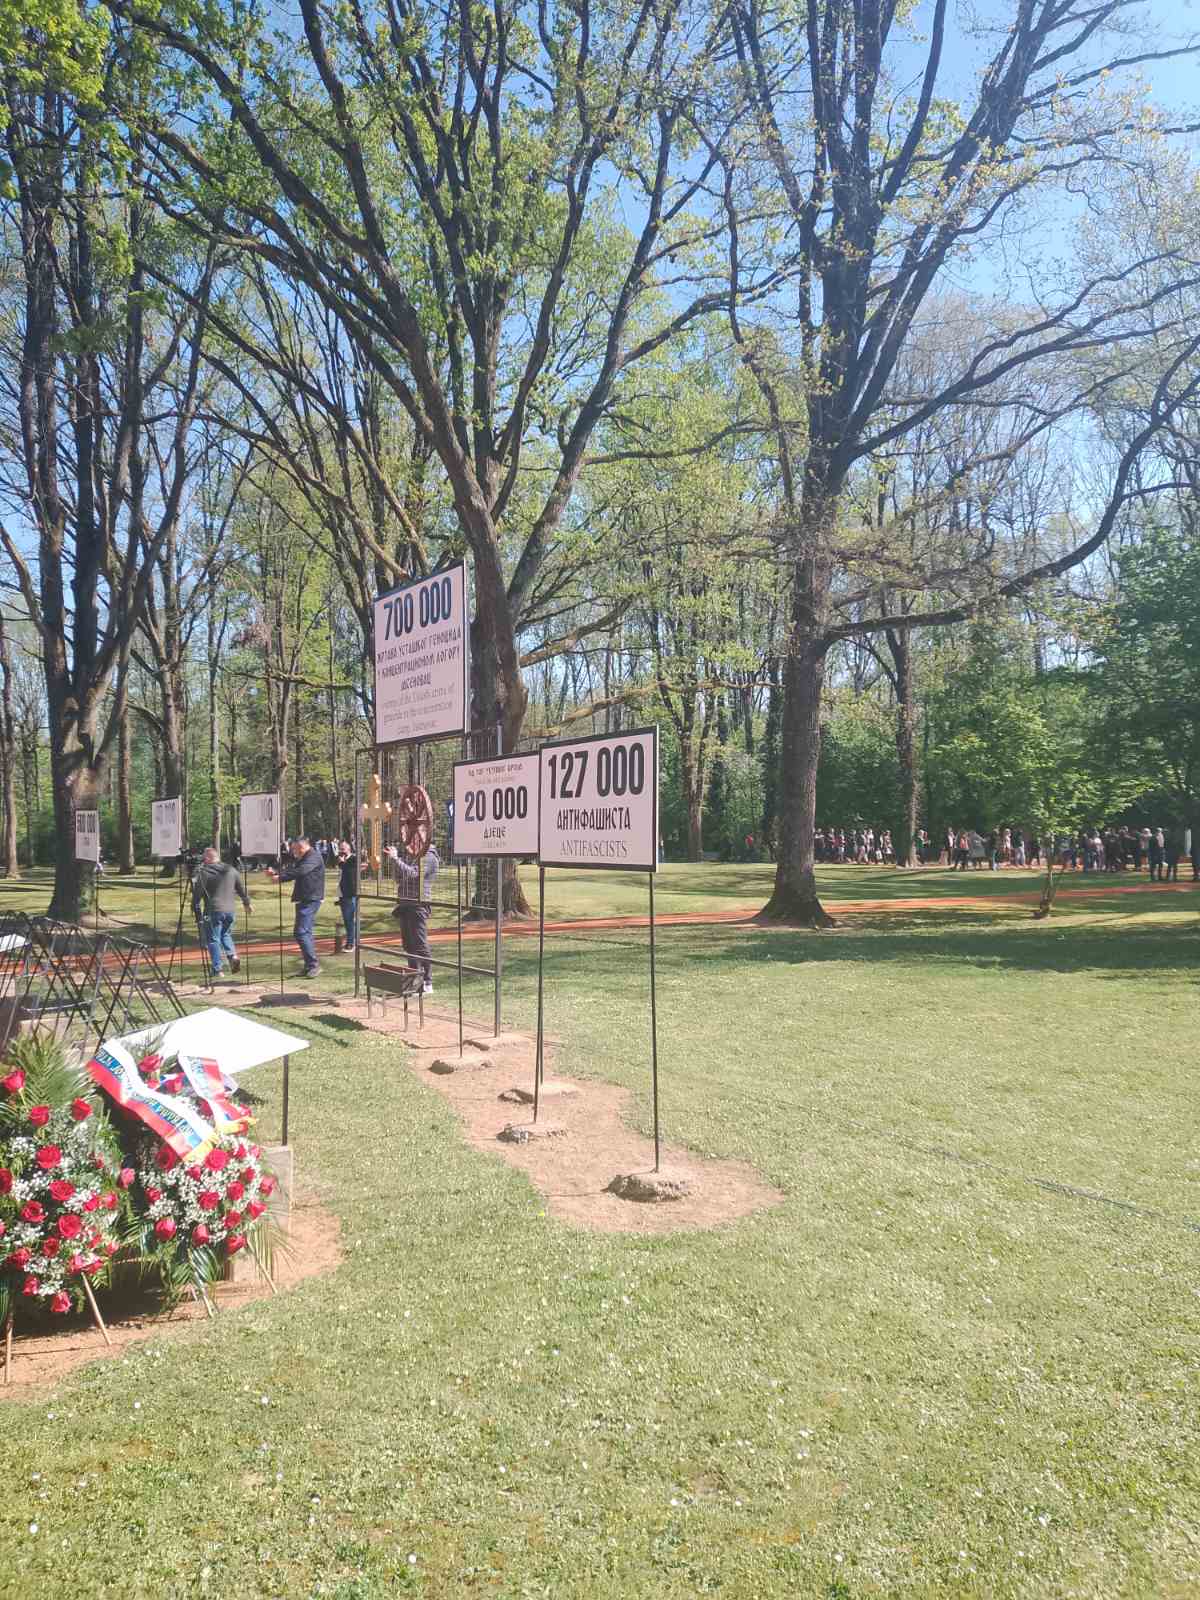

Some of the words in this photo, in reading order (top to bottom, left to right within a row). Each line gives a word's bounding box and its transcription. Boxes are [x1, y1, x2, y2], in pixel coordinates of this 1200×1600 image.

[384, 592, 413, 641] 700
[420, 577, 452, 628] 000
[548, 750, 589, 799] 127
[597, 742, 645, 797] 000
[465, 791, 486, 822] 20
[492, 785, 528, 820] 000
[484, 825, 507, 839] ДЈЕЦЕ
[557, 807, 631, 831] АНТИФАШИСТА
[560, 840, 628, 858] ANTIFASCISTS
